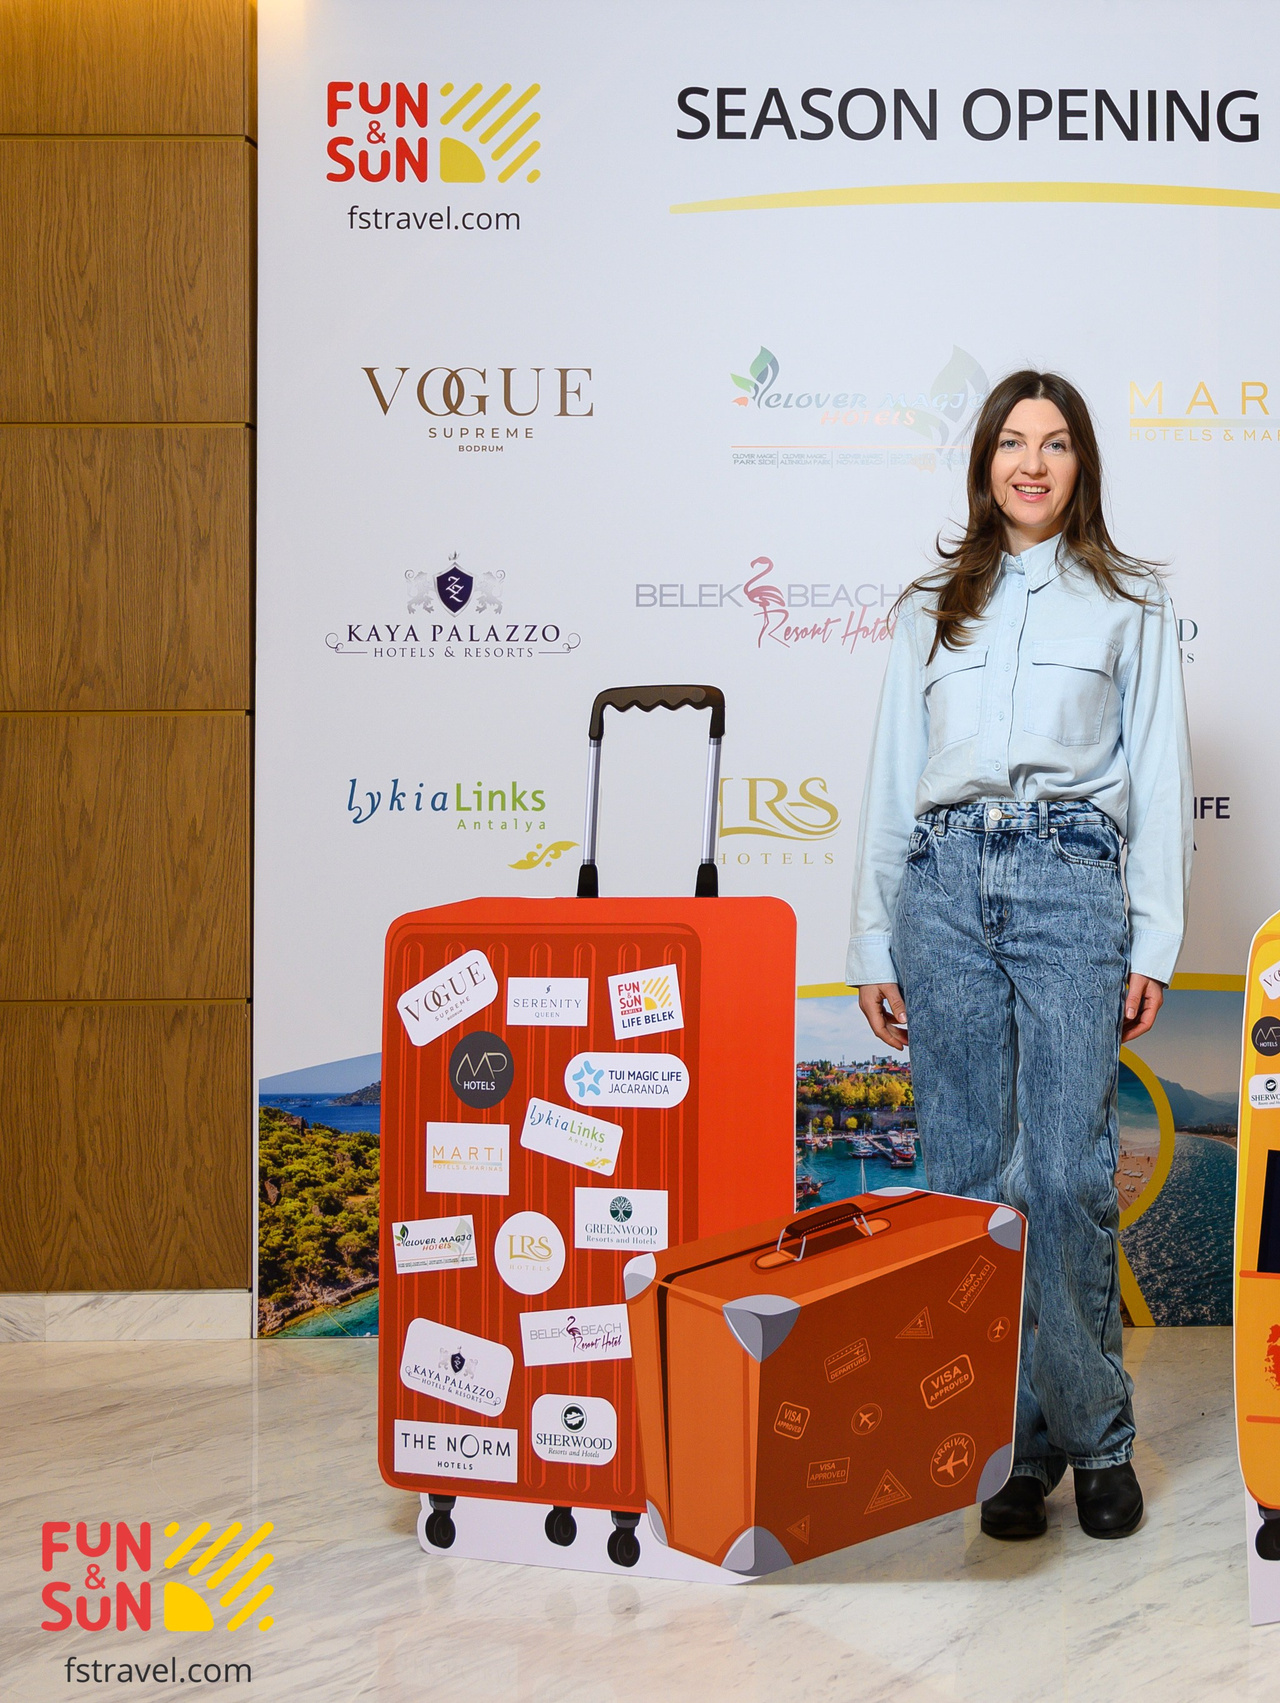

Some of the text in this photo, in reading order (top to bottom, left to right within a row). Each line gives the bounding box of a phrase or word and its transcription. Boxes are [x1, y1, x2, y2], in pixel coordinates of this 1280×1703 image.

[326, 81, 428, 128] FUN
[676, 87, 938, 141] SEASON
[962, 88, 1260, 142] OPENING
[366, 120, 386, 144] &
[326, 136, 428, 182] SUN
[348, 205, 521, 231] fstravel.com
[361, 366, 594, 417] VOGUE
[428, 427, 534, 438] SUPREME
[1130, 429, 1212, 442] HOTELS
[1222, 429, 1234, 442] &
[458, 444, 504, 452] BODRUM
[636, 584, 902, 608] BELEK BEACH
[347, 624, 560, 642] KAYA PALAZZO
[754, 609, 841, 649] Resort
[374, 646, 534, 658] HOTELS & RESORTS
[718, 776, 842, 842] LRS
[456, 818, 546, 832] Antalya
[404, 961, 486, 1022] VOGUE
[618, 981, 640, 996] FUN
[435, 996, 470, 1021] SUPREME
[513, 998, 582, 1008] SERENITY
[620, 994, 642, 1010] SUN
[622, 1010, 674, 1028] LIFE BELEK
[464, 1080, 496, 1090] HOTELS
[608, 1070, 682, 1082] TUI MAGIC LIFE
[608, 1084, 670, 1094] JACARANDA
[568, 1136, 602, 1152] Antalya
[432, 1146, 502, 1162] MARTI
[584, 1223, 658, 1236] GREENWOOD
[507, 1234, 553, 1262] LRS
[586, 1234, 656, 1245] Resorts and Hotels
[960, 1273, 976, 1292] VISA
[960, 1264, 990, 1308] APPROVED
[530, 1322, 622, 1340] BELEK BEACH
[830, 1356, 867, 1380] DEPARTURE
[413, 1364, 494, 1400] KAYA PALAZZO
[931, 1366, 962, 1390] VISA
[422, 1378, 446, 1390] HOTELS
[455, 1390, 482, 1404] RESORTS
[930, 1373, 969, 1402] APPROVED
[784, 1408, 802, 1424] VISA
[778, 1420, 802, 1433] APPROVED
[402, 1432, 511, 1458] THE NORM
[536, 1432, 612, 1450] SHERWOOD
[548, 1448, 568, 1456] Resorts
[582, 1450, 600, 1458] Hotels
[934, 1437, 970, 1464] ARRIVAL
[438, 1460, 473, 1470] HOTELS
[820, 1462, 836, 1471] VISA
[810, 1470, 846, 1481] APPROVED
